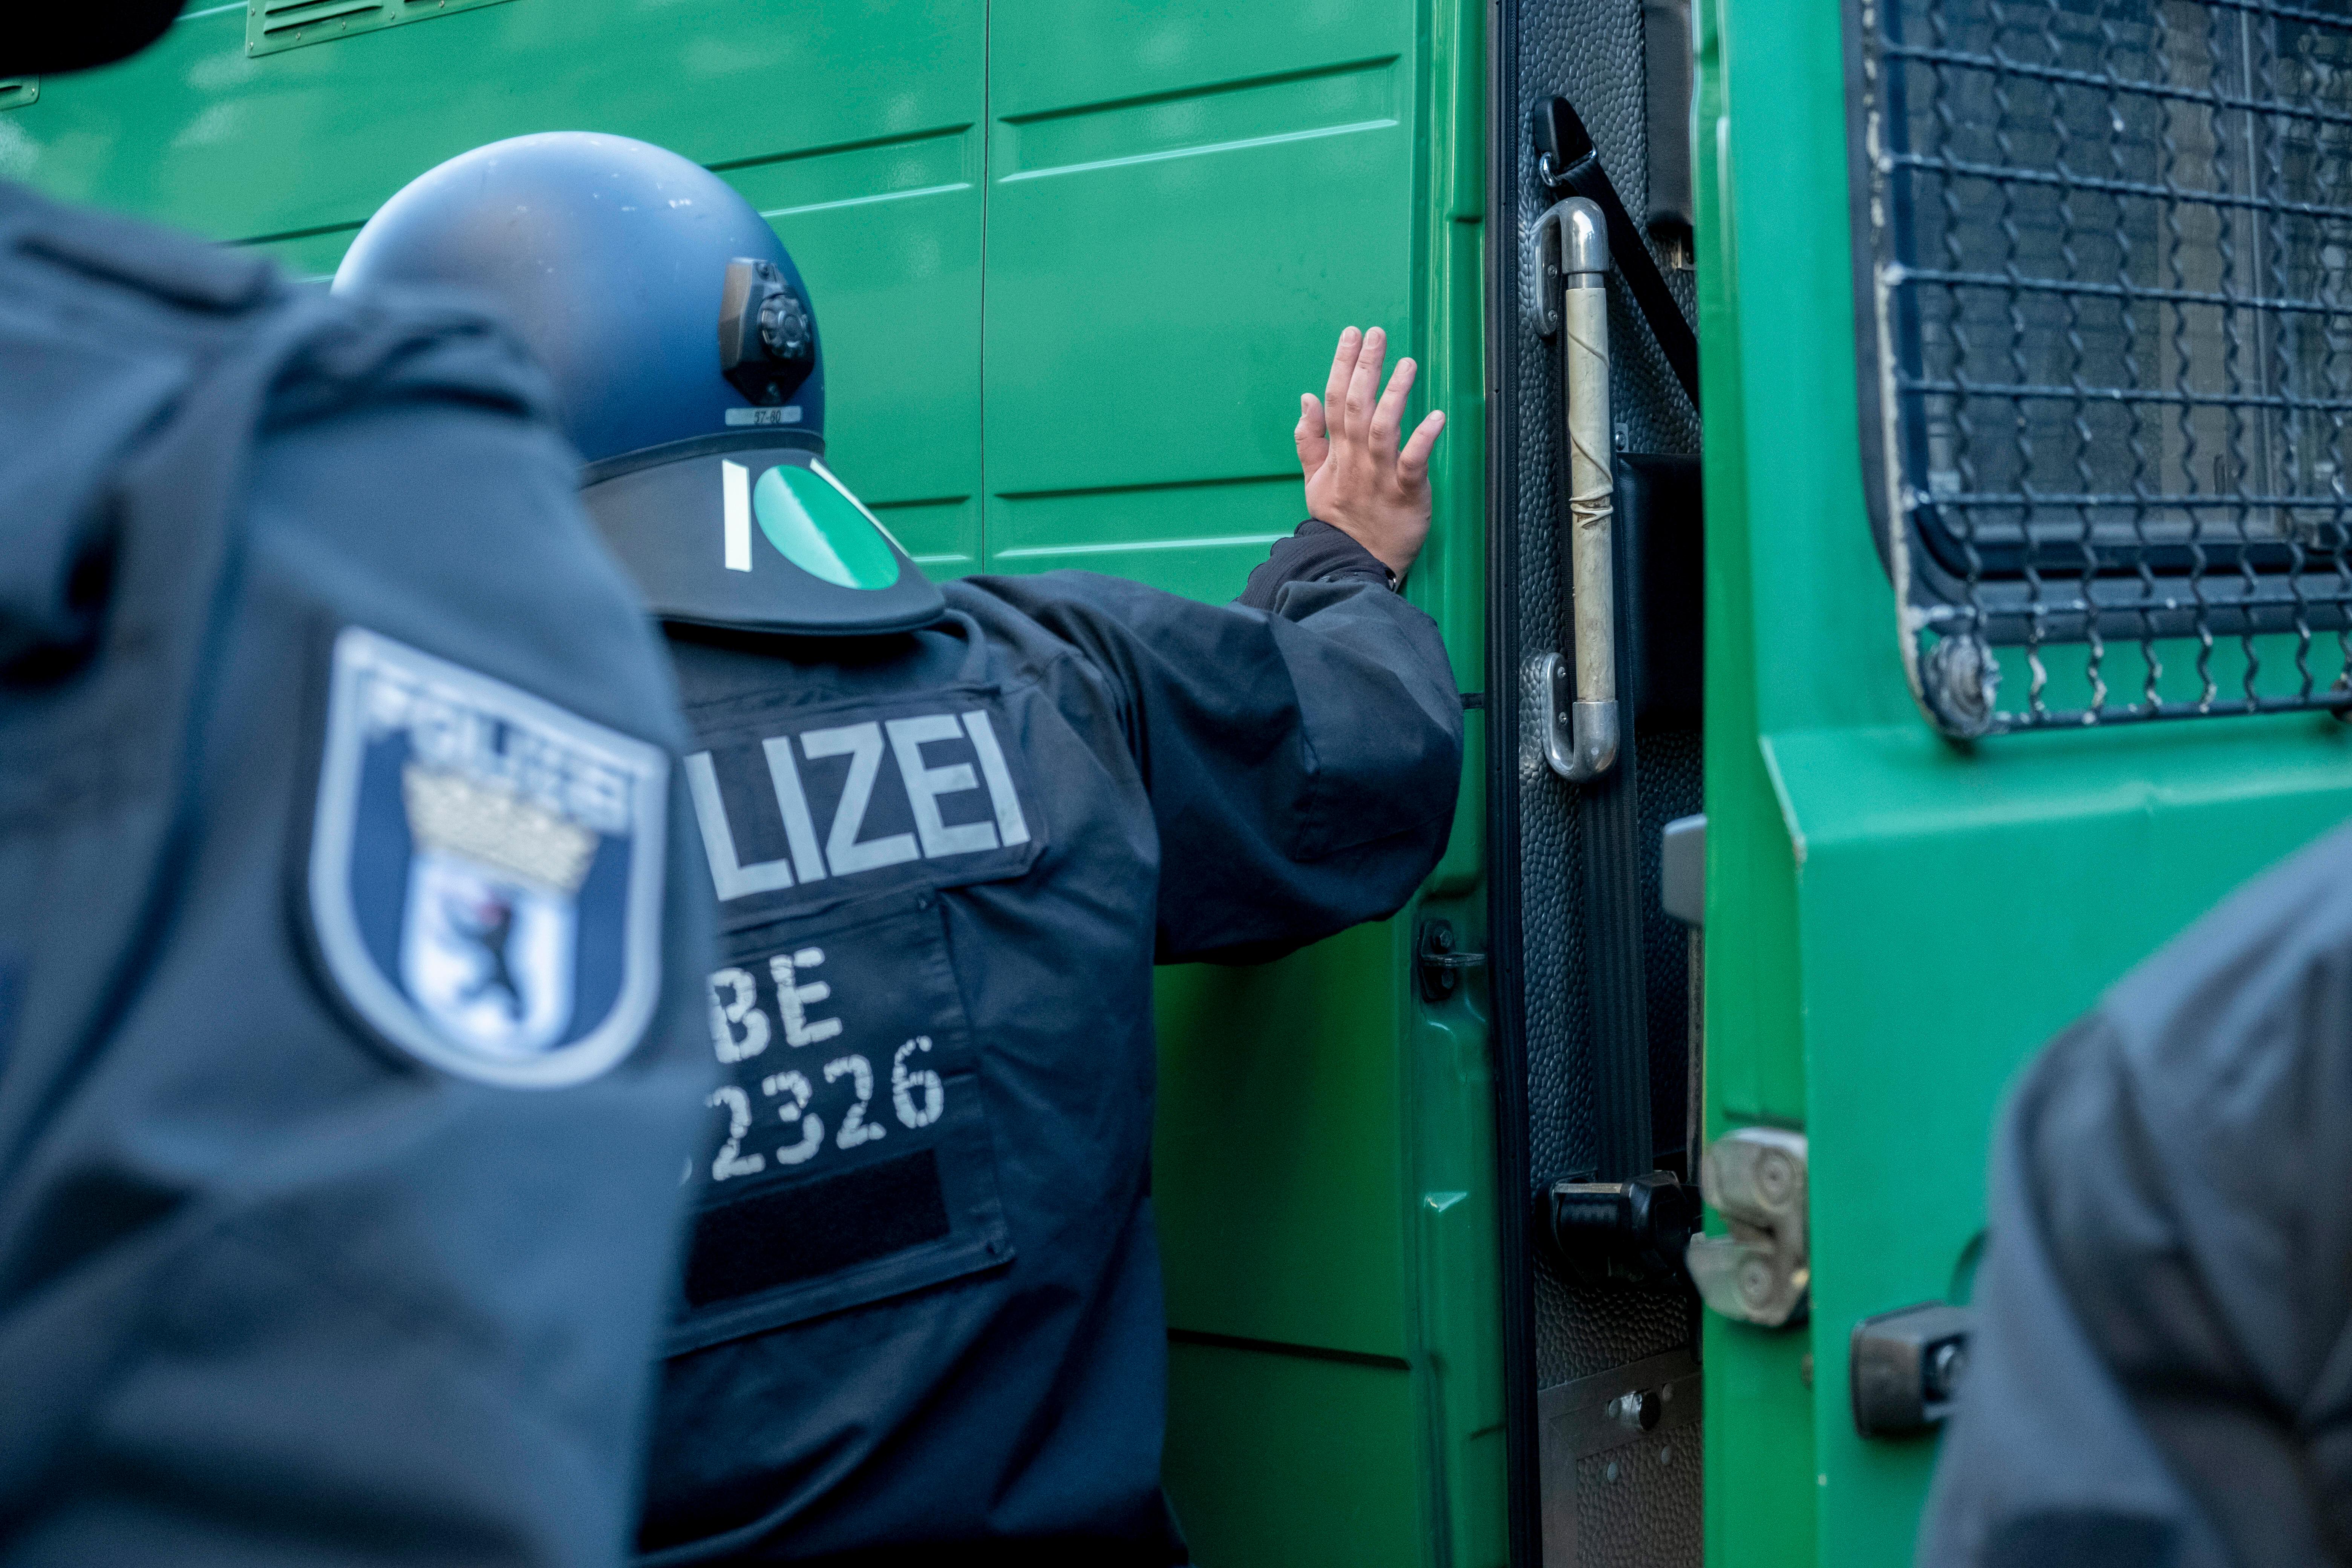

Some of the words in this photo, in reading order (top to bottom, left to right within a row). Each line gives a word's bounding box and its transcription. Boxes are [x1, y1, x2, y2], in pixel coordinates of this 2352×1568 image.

[683, 710, 1031, 902] LIZEI
[708, 947, 842, 1063] BE
[680, 1035, 944, 1184] 2326
